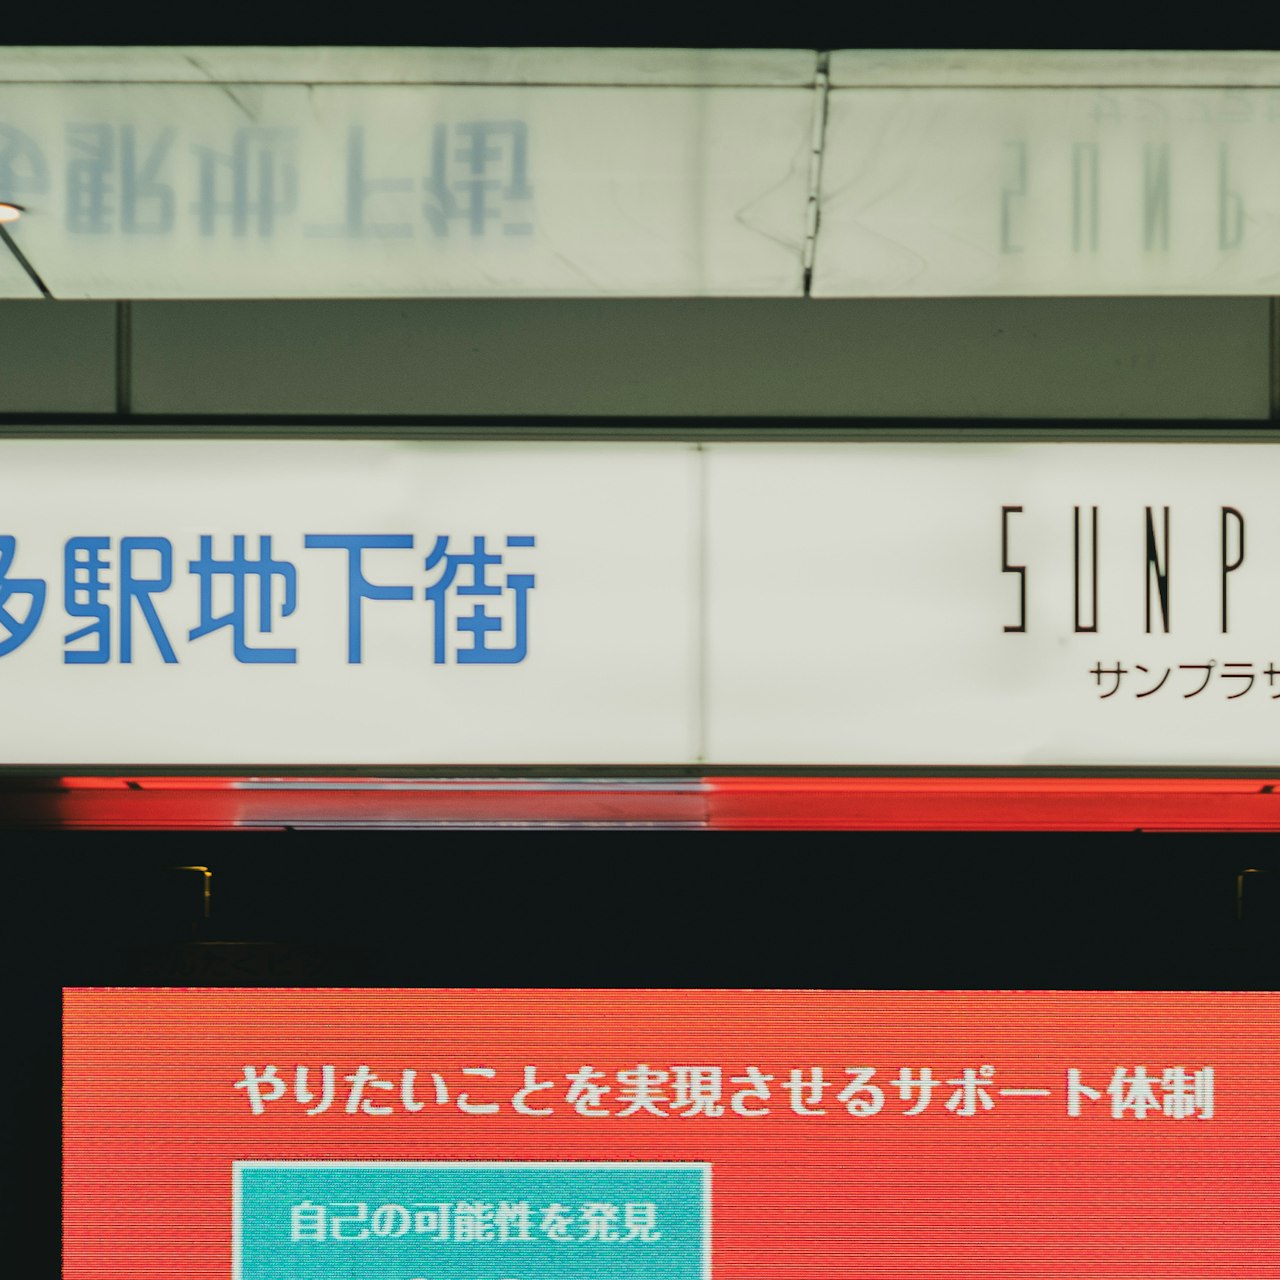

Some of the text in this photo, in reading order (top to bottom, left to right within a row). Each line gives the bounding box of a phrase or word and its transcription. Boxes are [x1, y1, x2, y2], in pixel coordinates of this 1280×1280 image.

[234, 1064, 1216, 1120] やりたいことを実現させるサポート体制
[289, 1200, 662, 1243] 自己の可能性を発見
